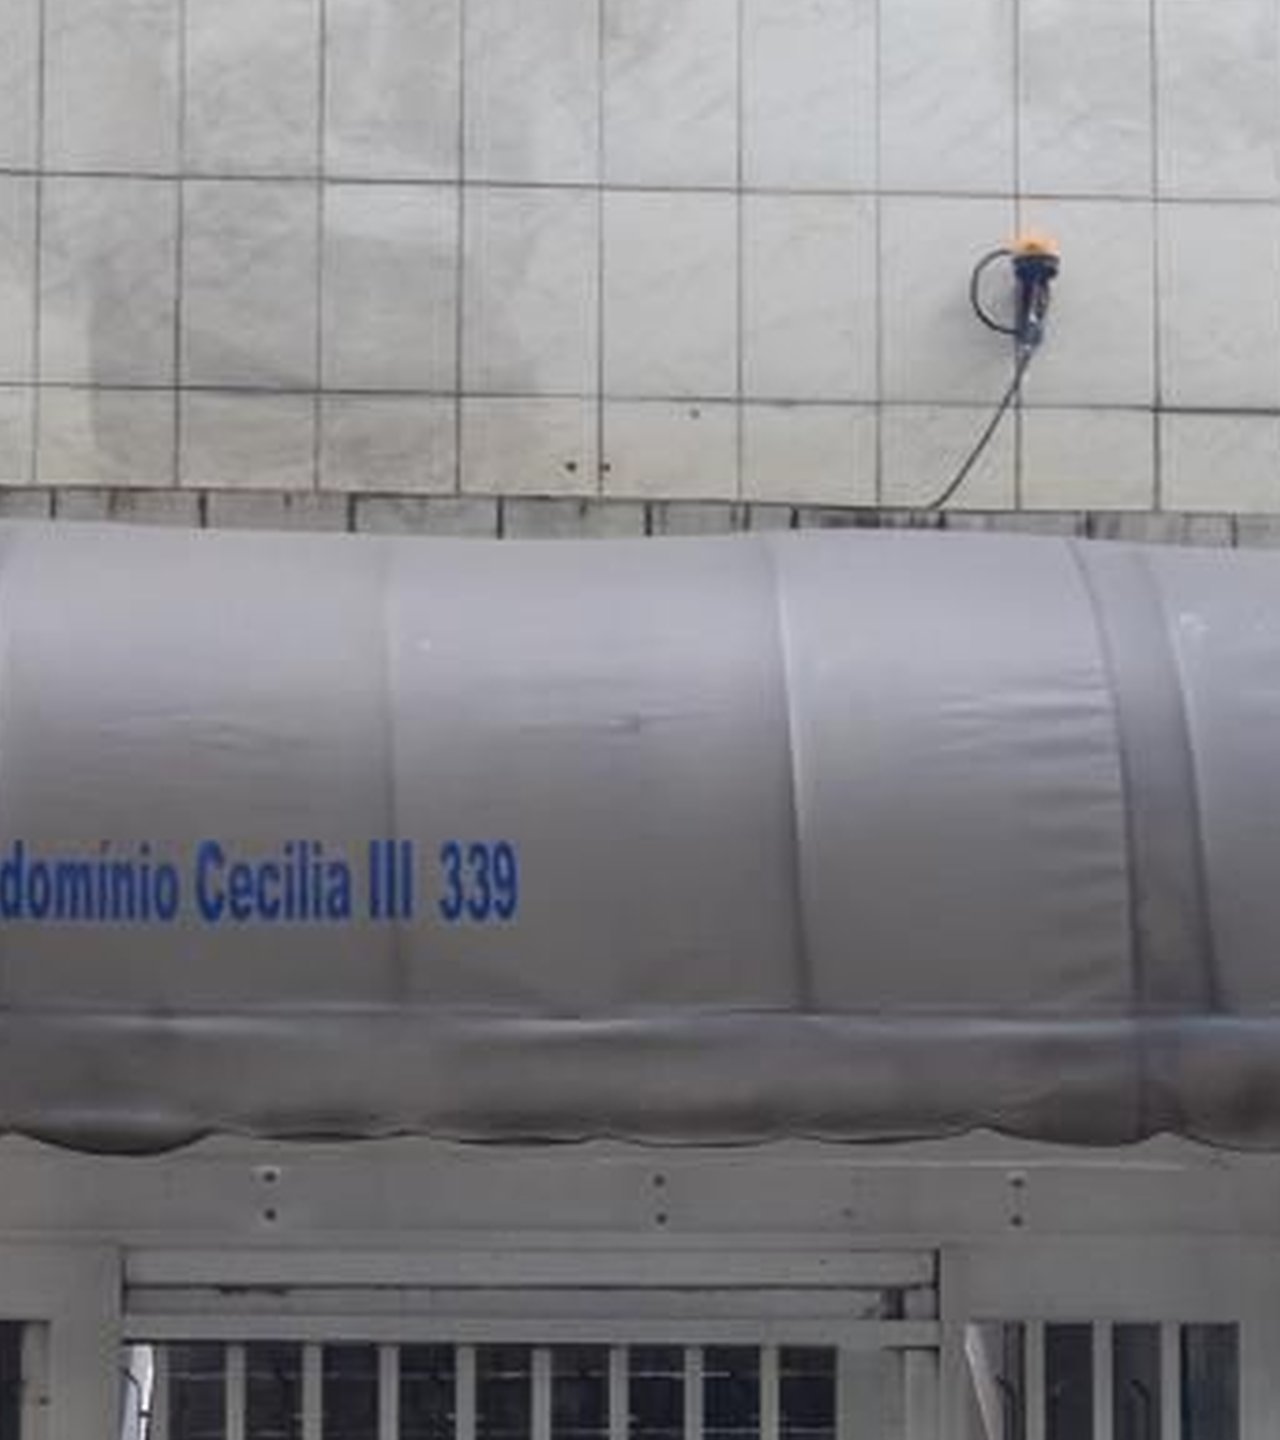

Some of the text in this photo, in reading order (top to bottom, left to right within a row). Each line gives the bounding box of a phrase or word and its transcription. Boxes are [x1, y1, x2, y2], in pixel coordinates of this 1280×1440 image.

[196, 838, 351, 921] Cecilia
[370, 839, 413, 920] III
[439, 840, 517, 921] 339
